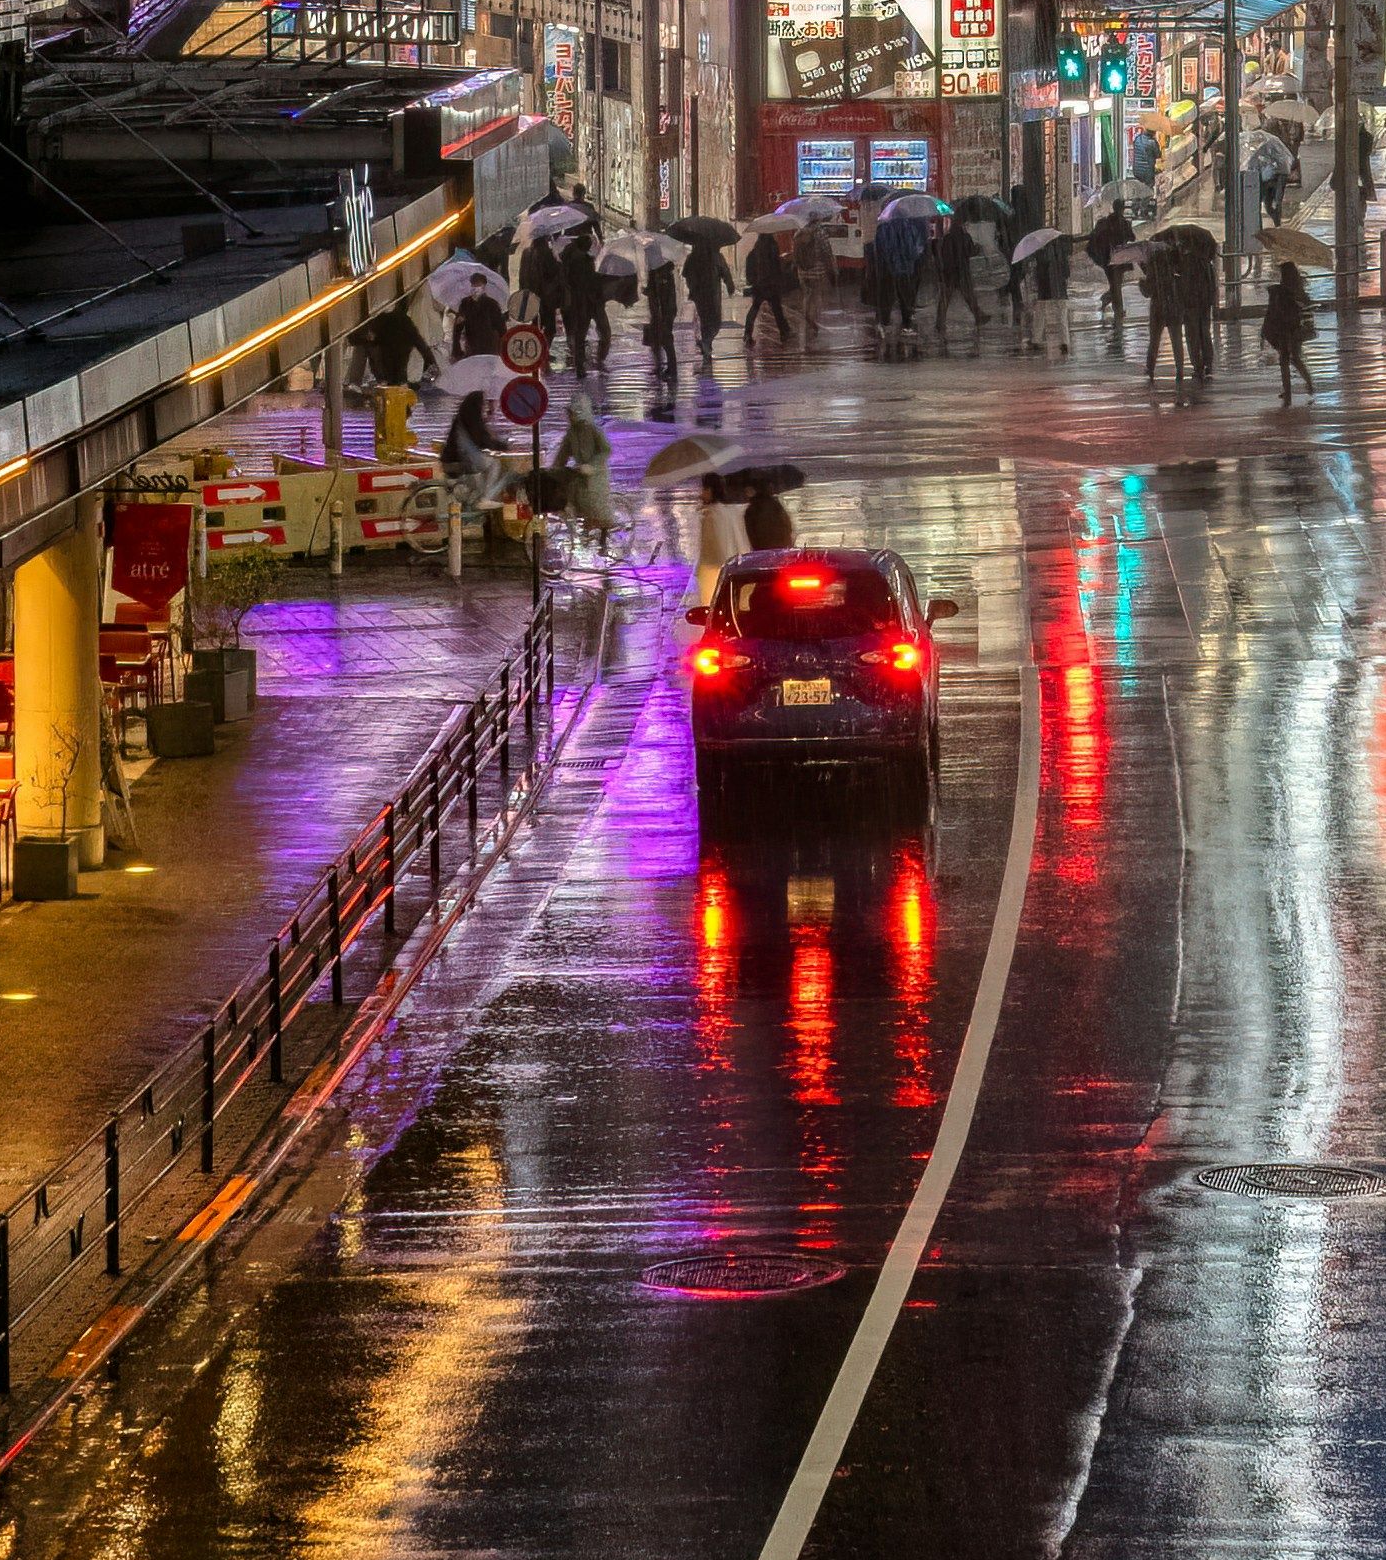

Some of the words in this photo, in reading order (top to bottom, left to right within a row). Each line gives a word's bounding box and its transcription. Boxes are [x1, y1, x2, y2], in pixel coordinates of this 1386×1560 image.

[816, 3, 842, 12] POINT
[902, 52, 932, 71] VISA
[508, 338, 539, 360] 30
[130, 562, 170, 579] atré
